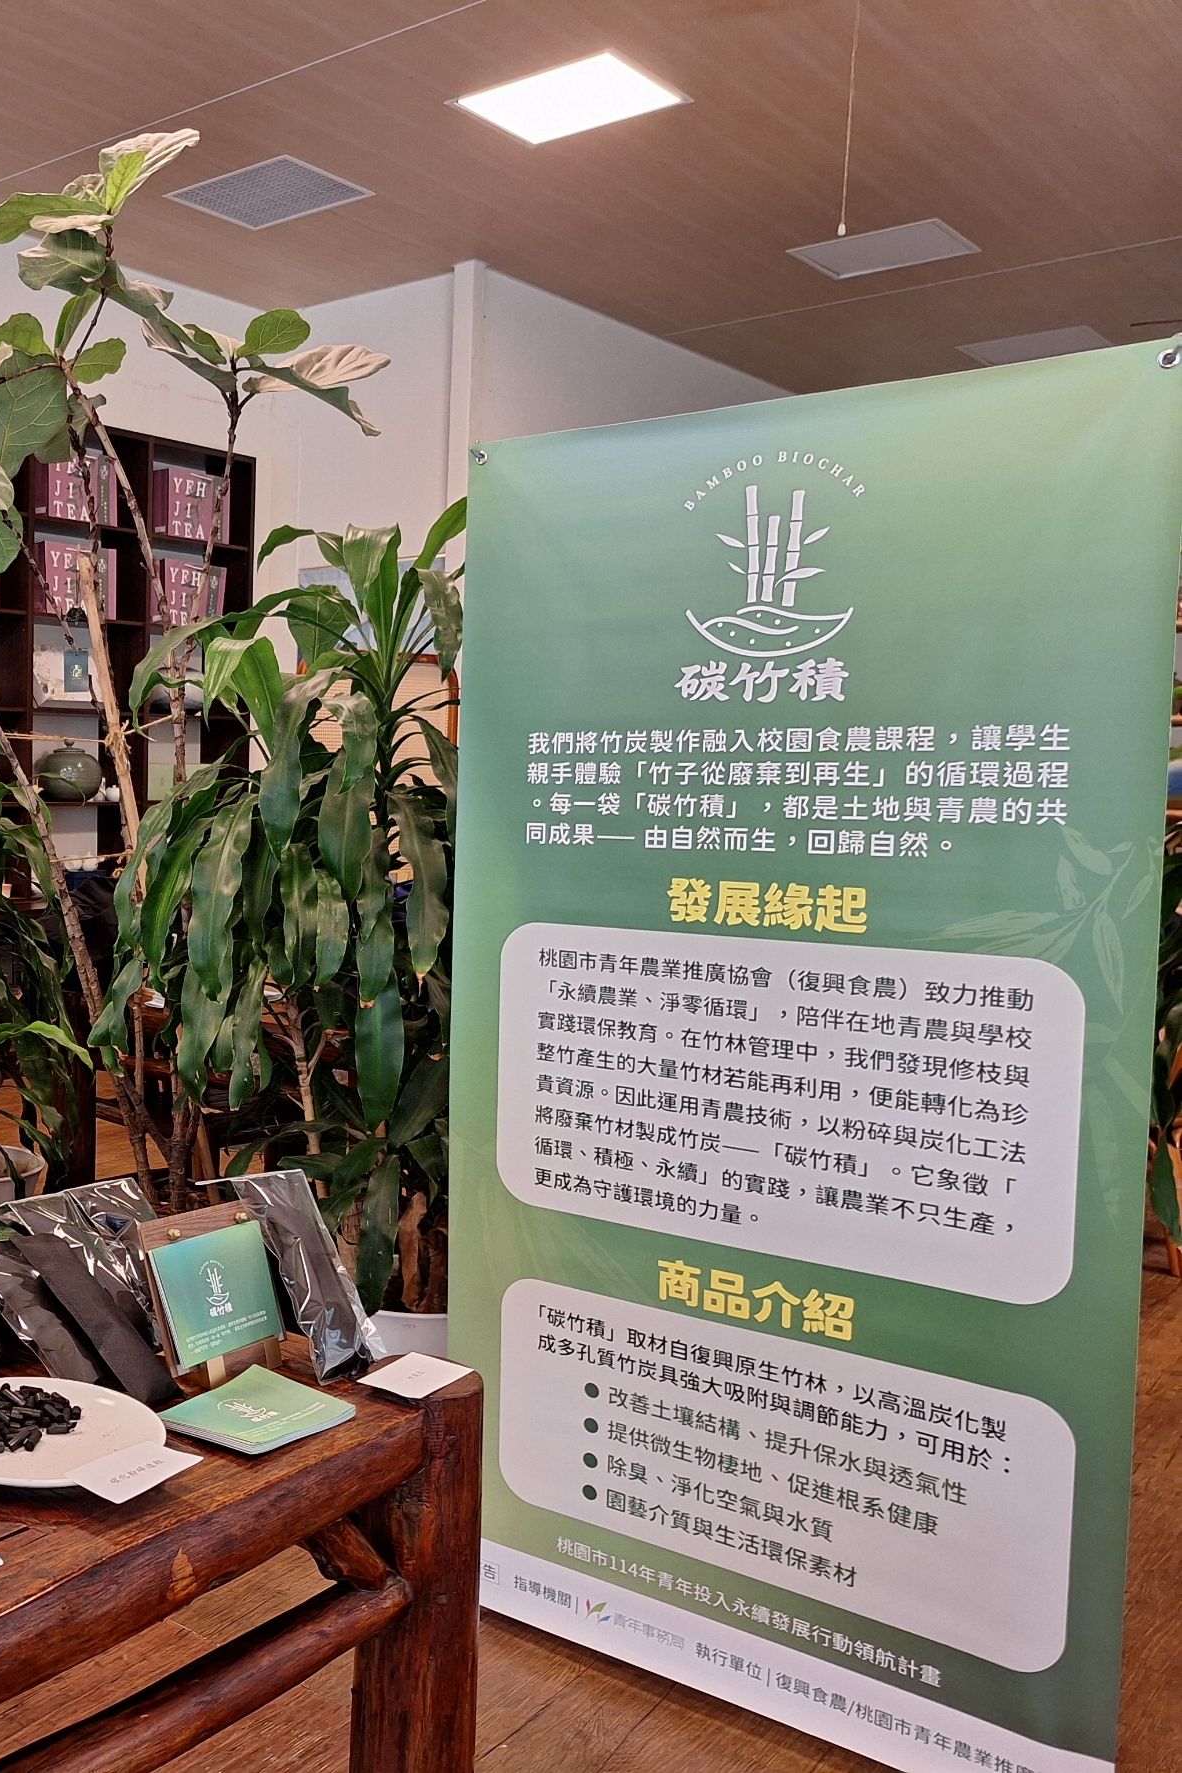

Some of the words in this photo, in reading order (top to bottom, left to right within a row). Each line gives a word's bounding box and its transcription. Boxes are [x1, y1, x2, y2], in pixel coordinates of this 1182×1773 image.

[173, 477, 207, 498] YEH
[173, 501, 192, 518] JI
[684, 455, 763, 511] BAMBOO
[778, 452, 865, 498] BIOCHAR
[53, 501, 90, 522] TEA
[172, 521, 205, 539] TEA
[171, 590, 187, 607] JI
[674, 657, 849, 703] 碳竹積
[528, 723, 1071, 755] 我們將竹炭製作融入校園食農課程，讓學生
[527, 760, 1069, 788] 親手體驗「竹子從廢棄到再生」的循環過程
[667, 878, 867, 934] 發展緣起
[534, 1167, 760, 1225] 更成為守護環境的力量。
[658, 1260, 854, 1341] 商品介紹
[609, 1386, 968, 1506] 改善土壤結構、提升保水與透氣性
[607, 1454, 834, 1543] 除臭、淨化空氣與水質
[608, 1420, 938, 1536] 提供微生物棲地、促進根系健康
[606, 1488, 857, 1587] 園藝介質與生活環保素材
[556, 1536, 942, 1688] 桃園市114年青年投入永續發展行動領航計畫
